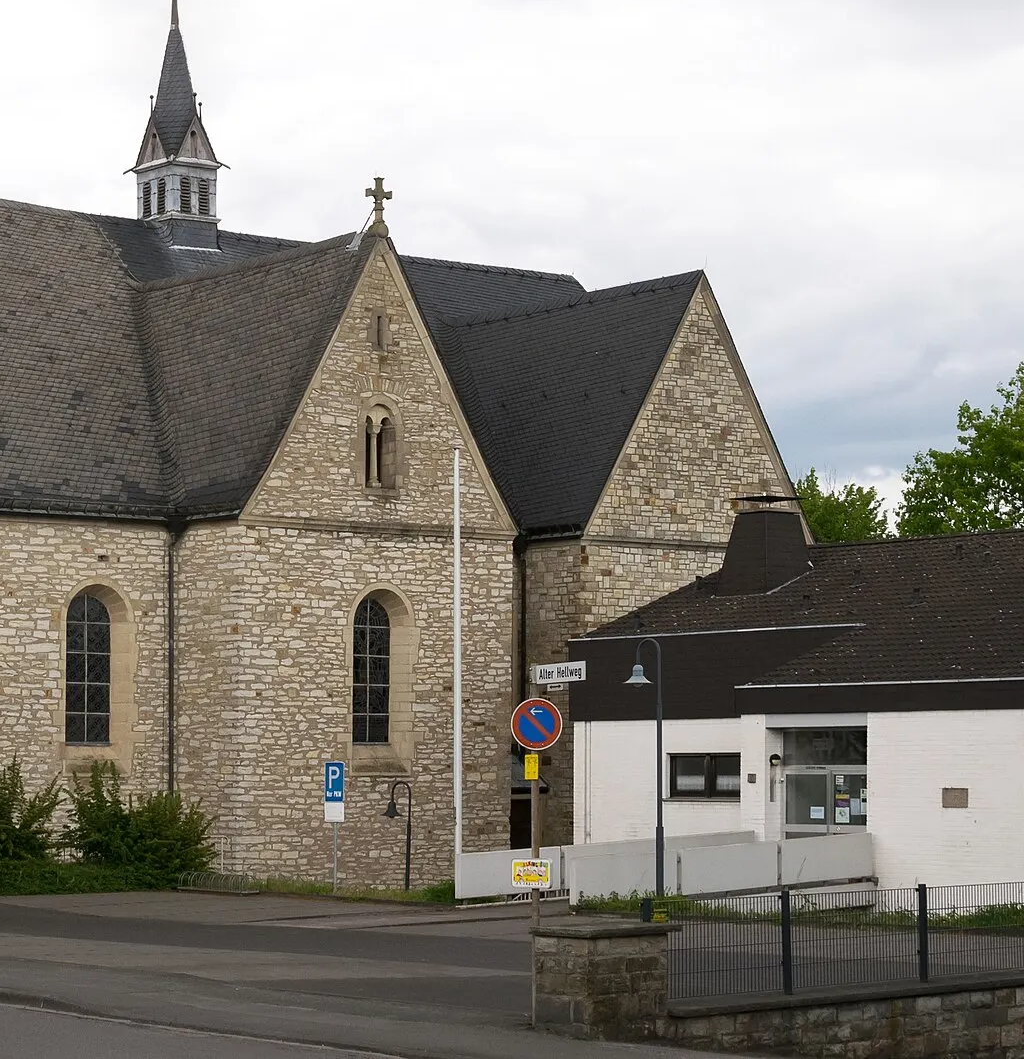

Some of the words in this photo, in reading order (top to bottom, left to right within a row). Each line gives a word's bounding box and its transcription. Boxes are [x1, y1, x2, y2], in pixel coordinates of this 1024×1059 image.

[539, 668, 554, 680] Alter
[556, 666, 582, 679] Hellweg
[328, 766, 340, 789] P
